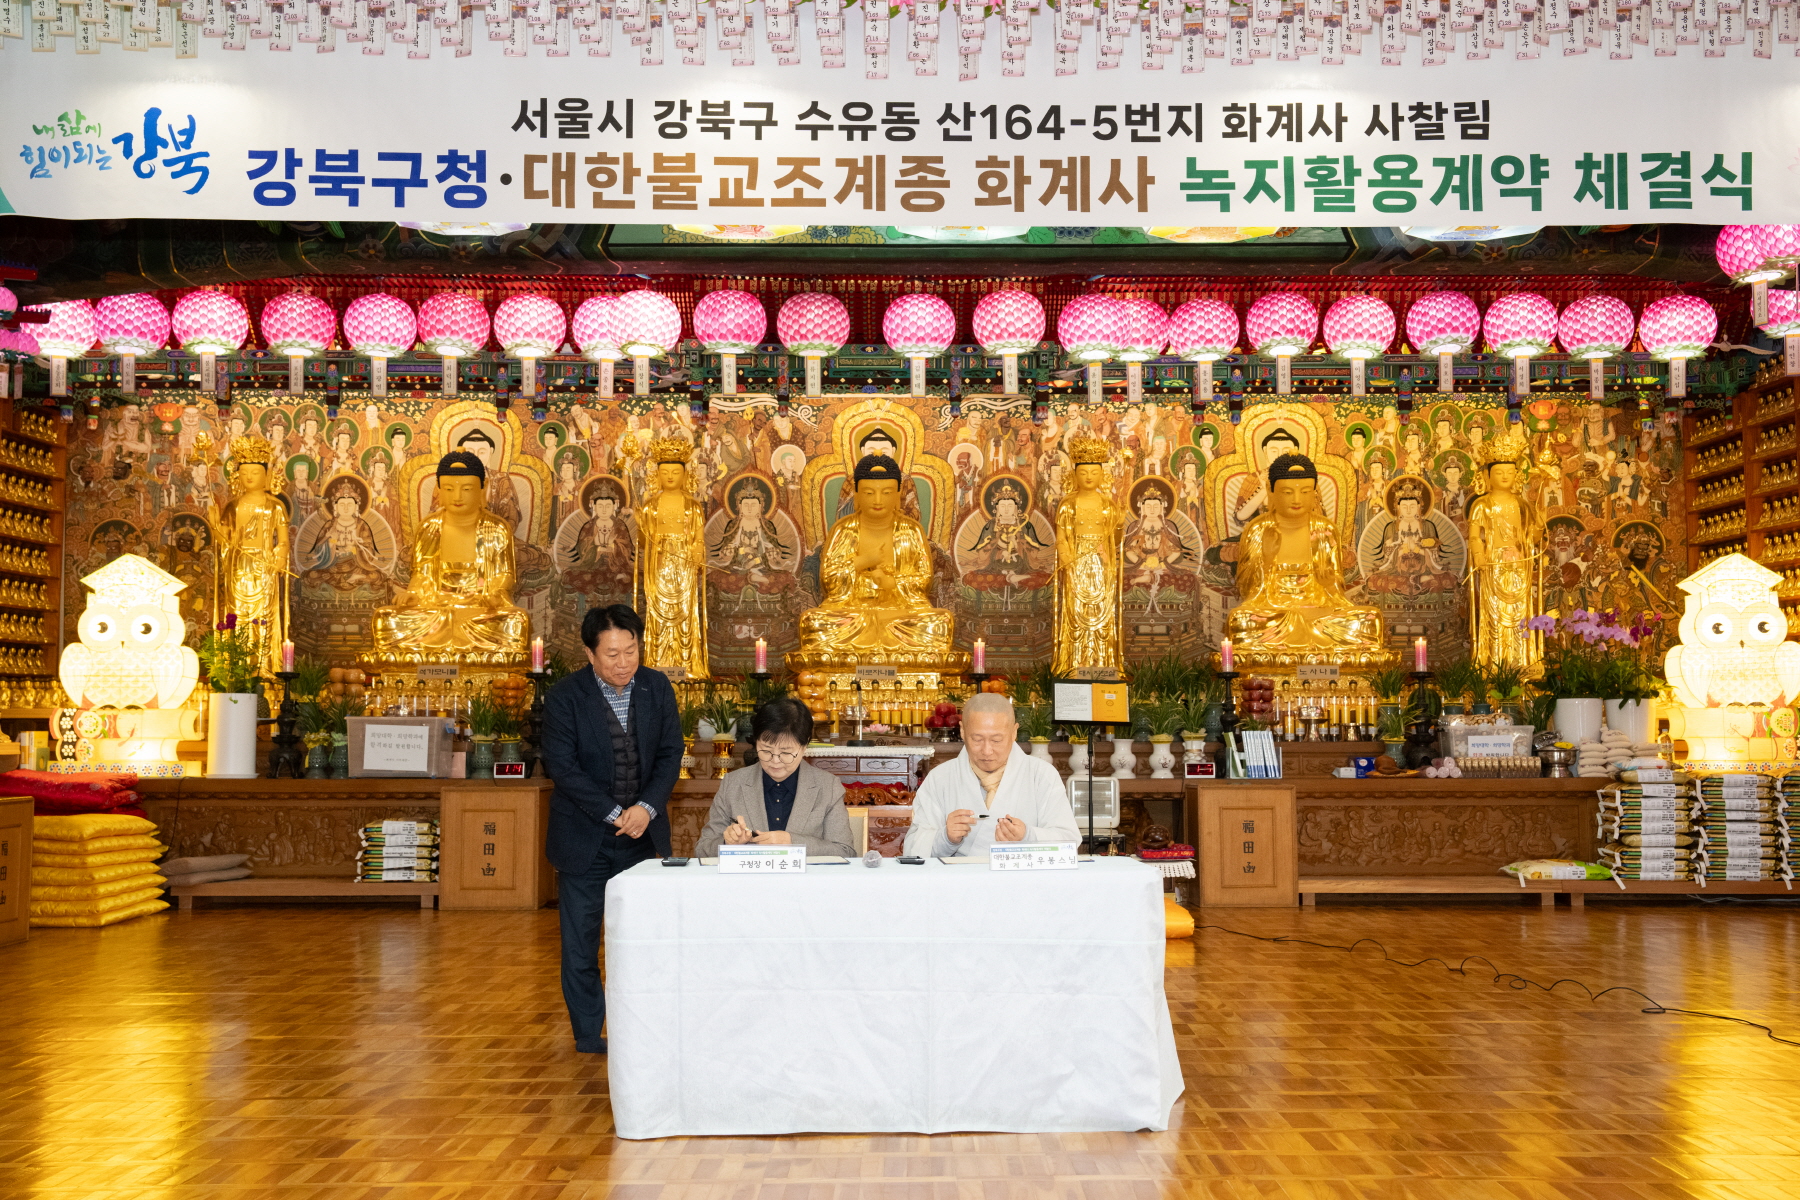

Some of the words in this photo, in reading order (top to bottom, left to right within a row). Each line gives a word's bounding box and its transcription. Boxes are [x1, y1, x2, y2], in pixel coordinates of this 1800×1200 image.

[511, 98, 633, 138] 서울시
[654, 100, 777, 140] 강북구
[796, 101, 919, 141] 수유동
[937, 102, 1202, 142] 산164-5번지
[1222, 103, 1347, 142] 화계사
[1365, 100, 1489, 141] 사찰림
[111, 107, 210, 195] 강북
[975, 154, 1155, 213] 화계사
[1180, 154, 1549, 213] 녹지활용계약
[1574, 151, 1752, 212] 체결식
[739, 860, 761, 869] 구청장
[993, 853, 1033, 862] 대한불교조계종
